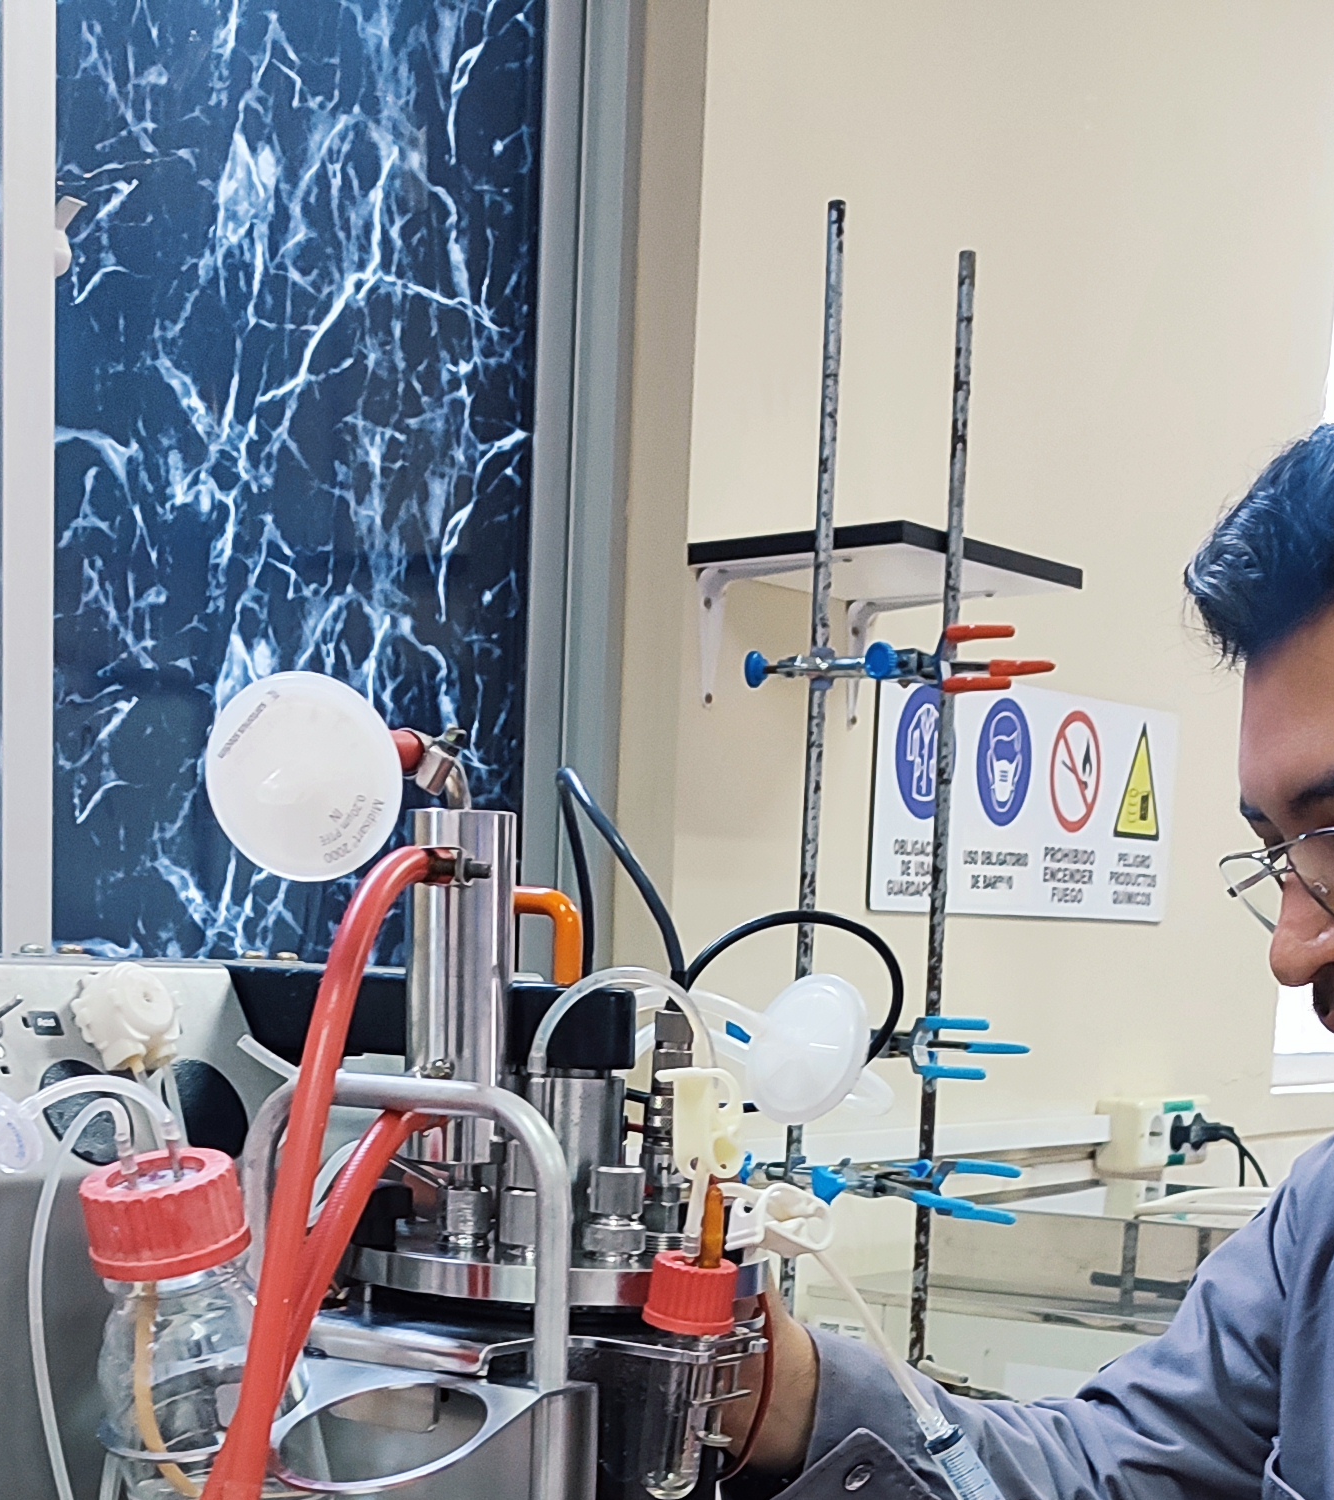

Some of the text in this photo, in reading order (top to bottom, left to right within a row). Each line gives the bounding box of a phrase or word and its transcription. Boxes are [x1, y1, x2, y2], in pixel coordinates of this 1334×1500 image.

[1043, 846, 1096, 866] PROHIBIDO
[1117, 852, 1151, 869] PELIGRO
[914, 860, 932, 877] USA
[1042, 866, 1094, 885] ENCENDER
[1108, 870, 1157, 888] PRODUCTOS
[1051, 886, 1083, 904] FUEGO
